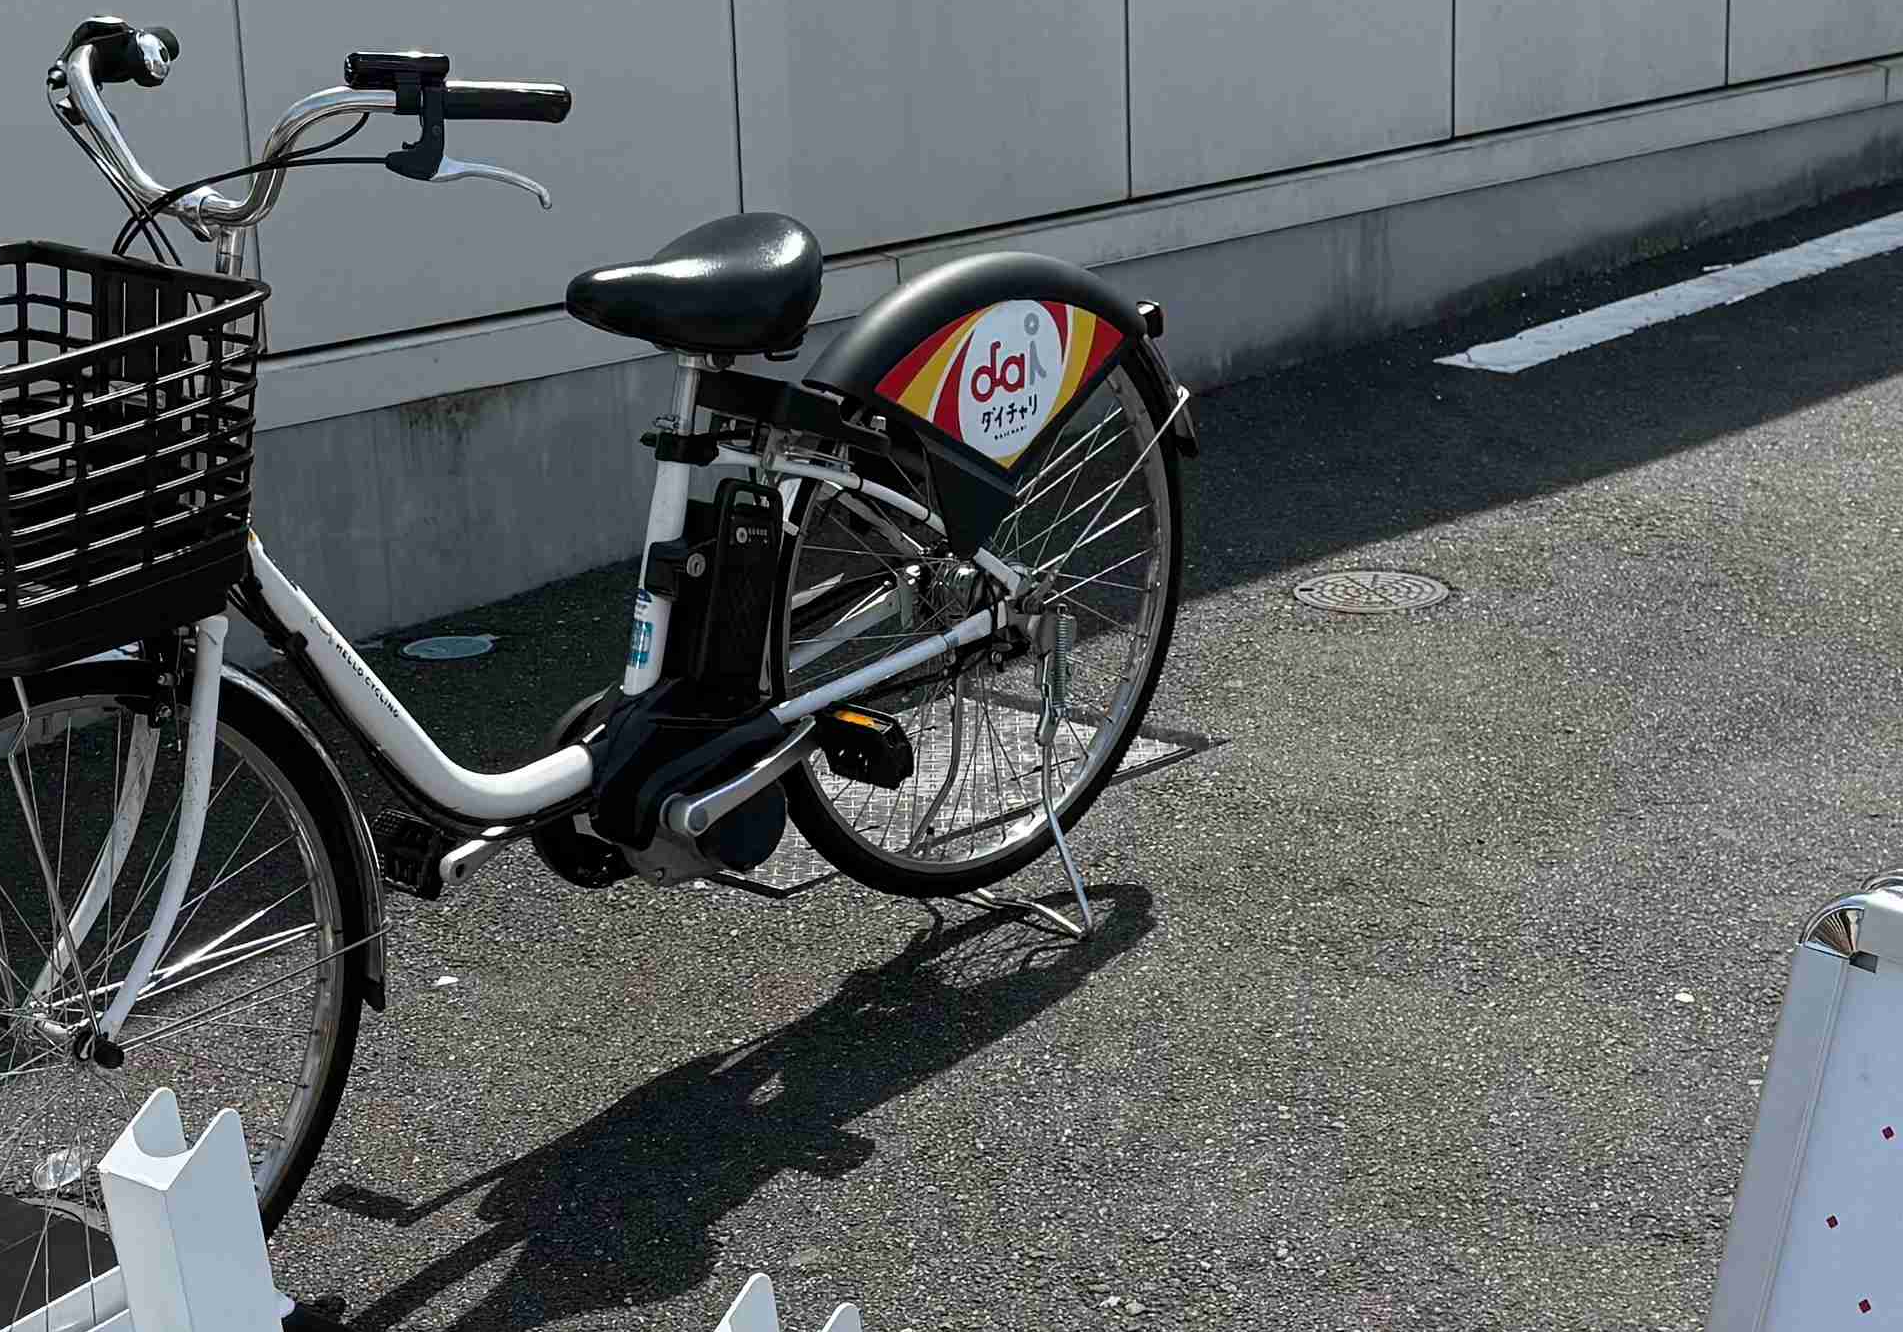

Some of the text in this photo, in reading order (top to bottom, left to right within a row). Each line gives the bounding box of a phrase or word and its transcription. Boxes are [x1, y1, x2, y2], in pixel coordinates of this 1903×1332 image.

[971, 313, 1047, 403] dai
[982, 394, 1038, 434] ダイチャリ
[336, 643, 399, 718] HELLO CYCLING
